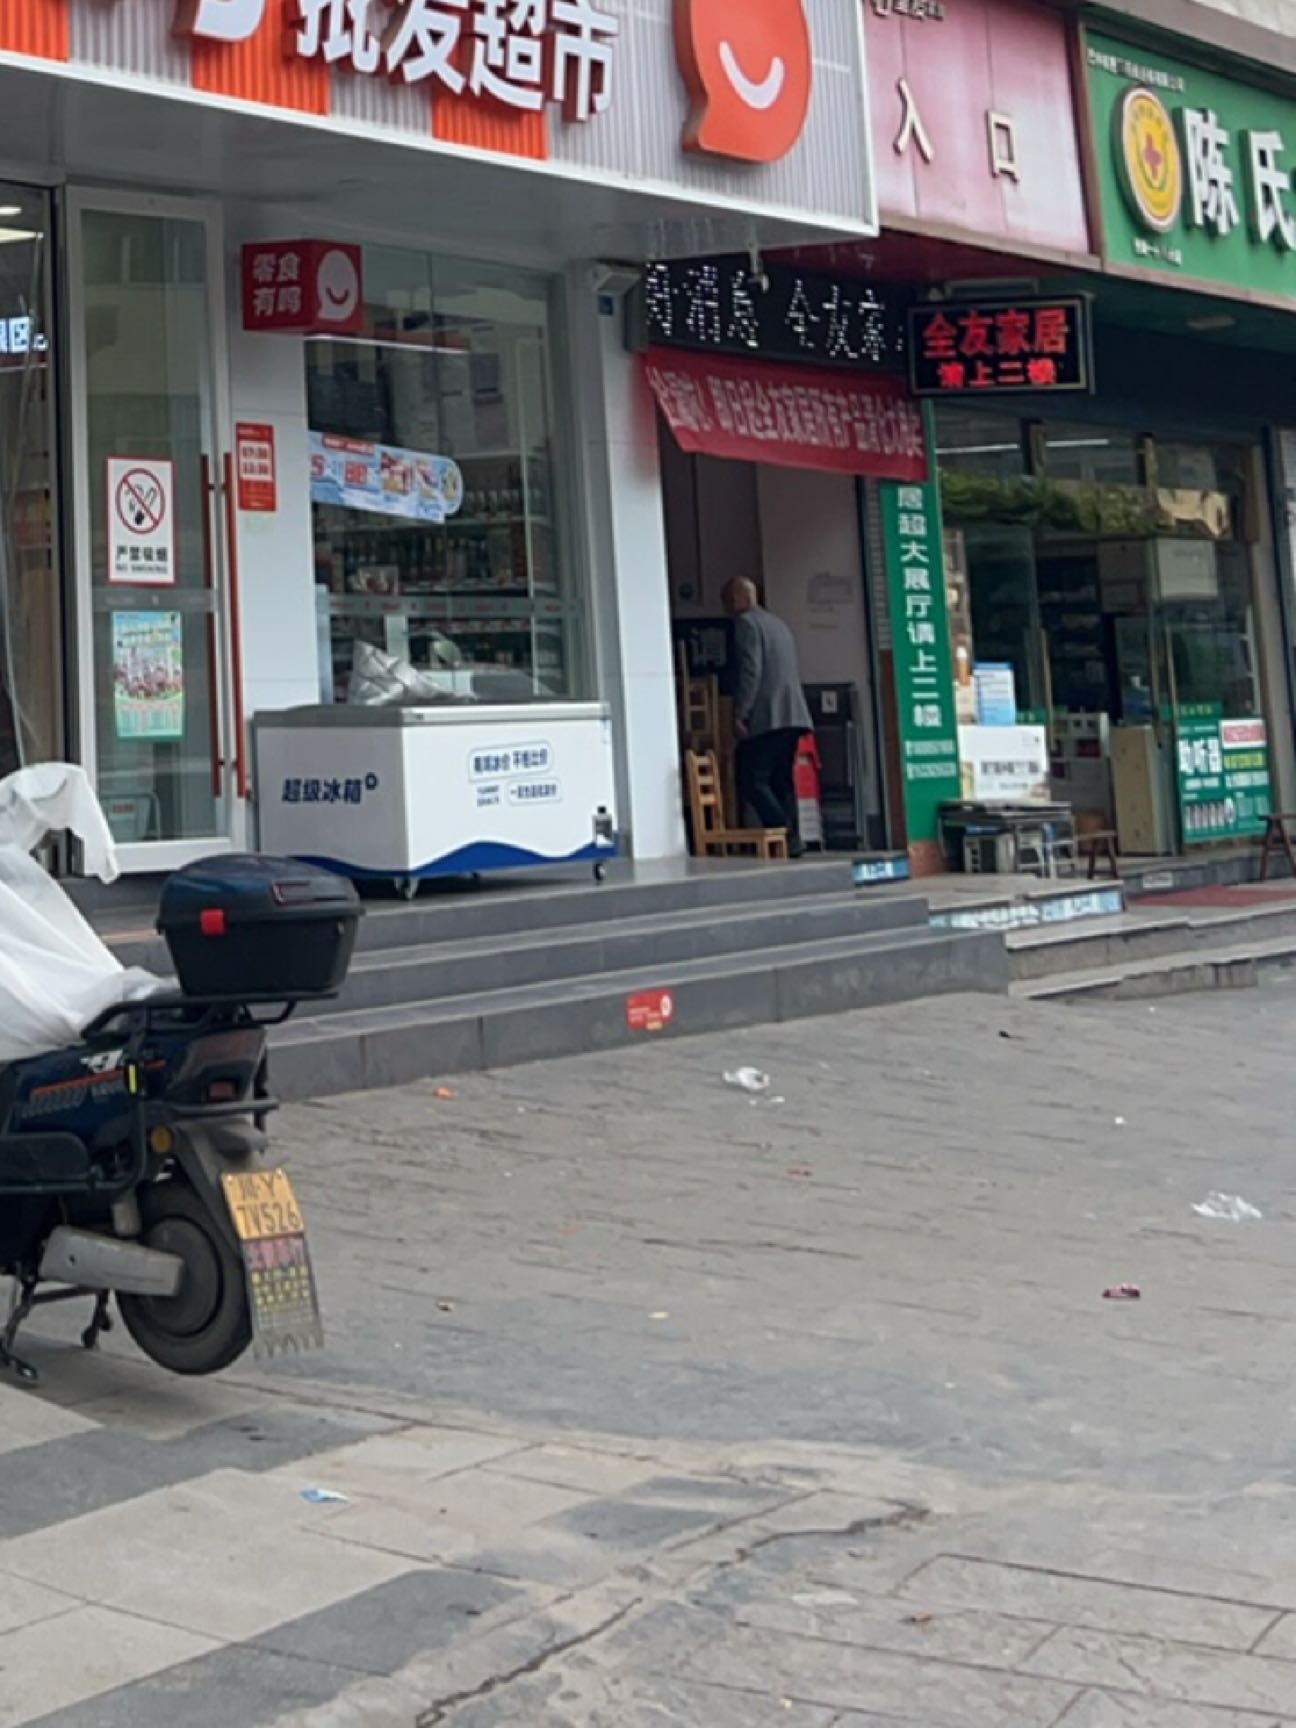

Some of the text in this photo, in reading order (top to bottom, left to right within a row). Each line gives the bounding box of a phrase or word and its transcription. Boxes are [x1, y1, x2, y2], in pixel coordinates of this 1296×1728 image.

[892, 77, 1022, 183] 入口
[1172, 106, 1296, 254] 陈氏
[253, 252, 301, 283] 零食
[253, 285, 302, 317] 有鸣
[785, 278, 904, 362] 全友家
[922, 308, 1071, 359] 全友家居
[115, 545, 168, 562] 严禁吸烟
[281, 776, 363, 804] 超级冰箱
